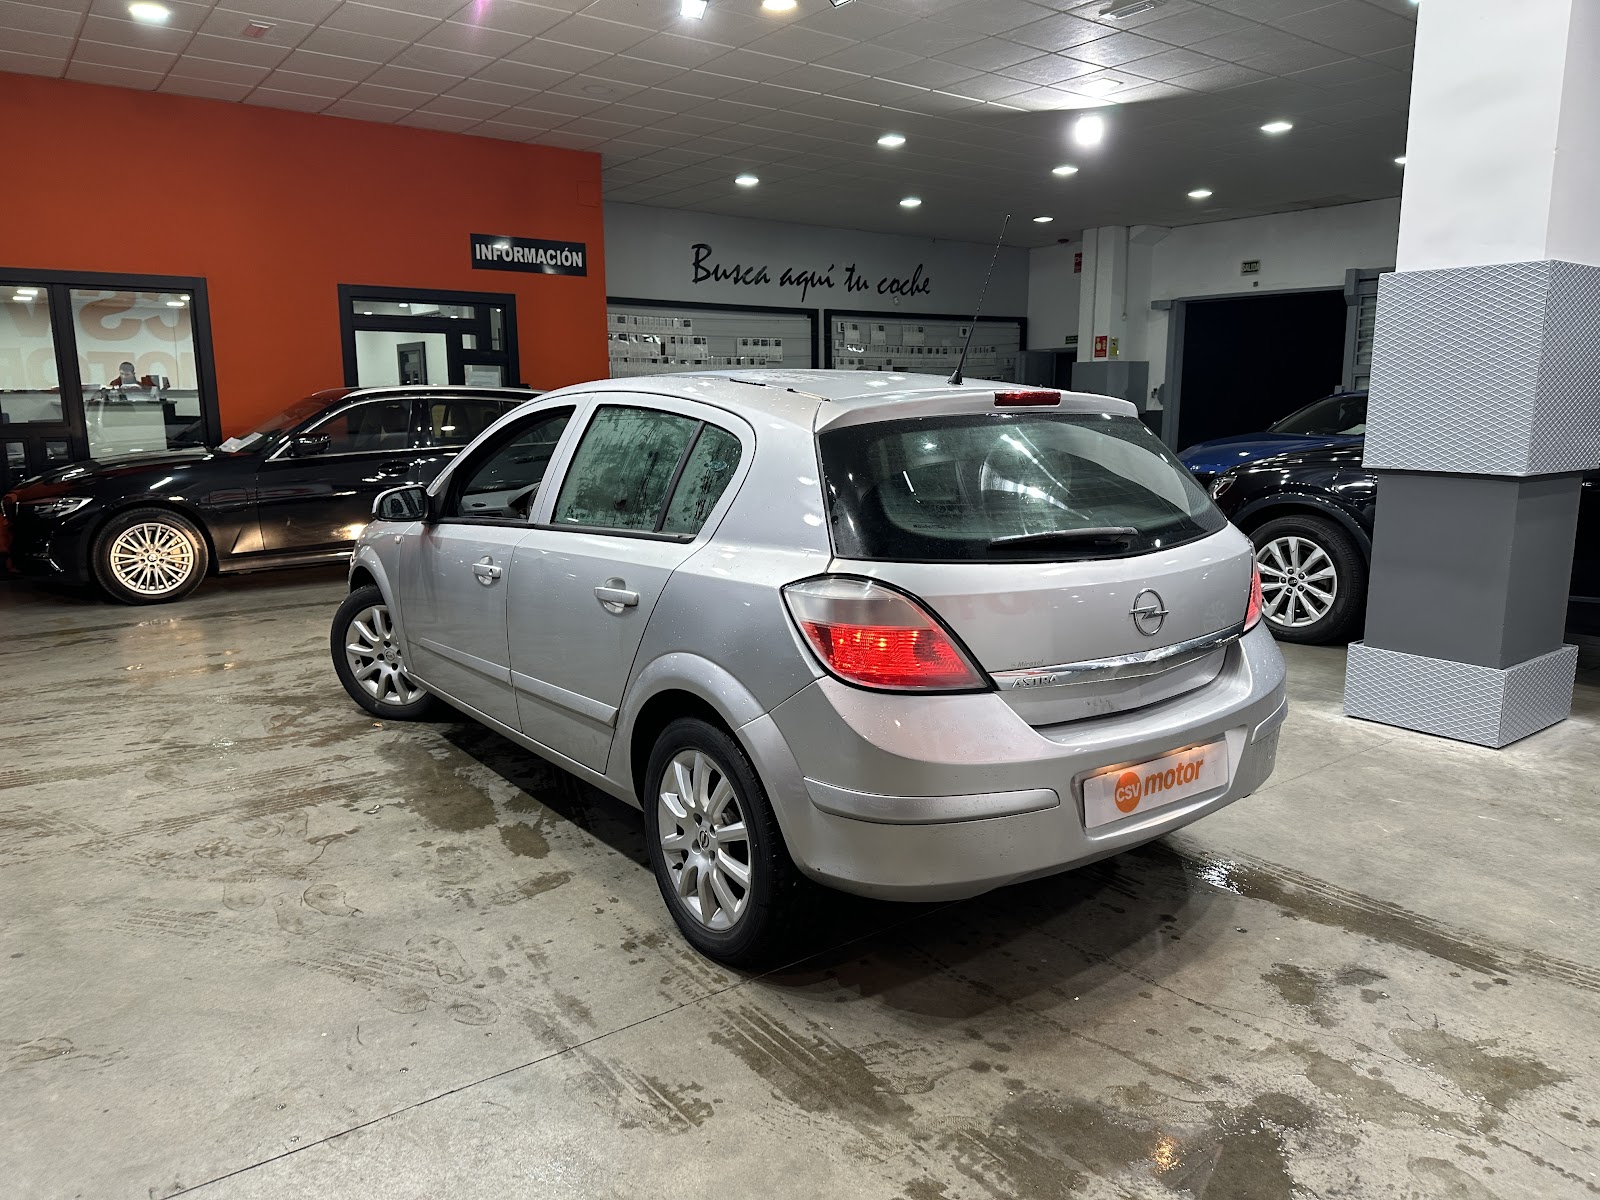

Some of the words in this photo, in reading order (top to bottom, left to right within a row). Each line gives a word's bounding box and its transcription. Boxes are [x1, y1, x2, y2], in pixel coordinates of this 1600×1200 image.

[475, 243, 583, 268] INFORMACIÓN
[1242, 262, 1259, 272] SALIDA
[691, 243, 771, 285] Busca
[779, 263, 835, 303] aquí
[844, 263, 869, 293] tu
[877, 263, 931, 297] coche
[1011, 674, 1057, 689] ASTRA
[1116, 782, 1140, 803] CSV
[1143, 759, 1204, 797] motor
